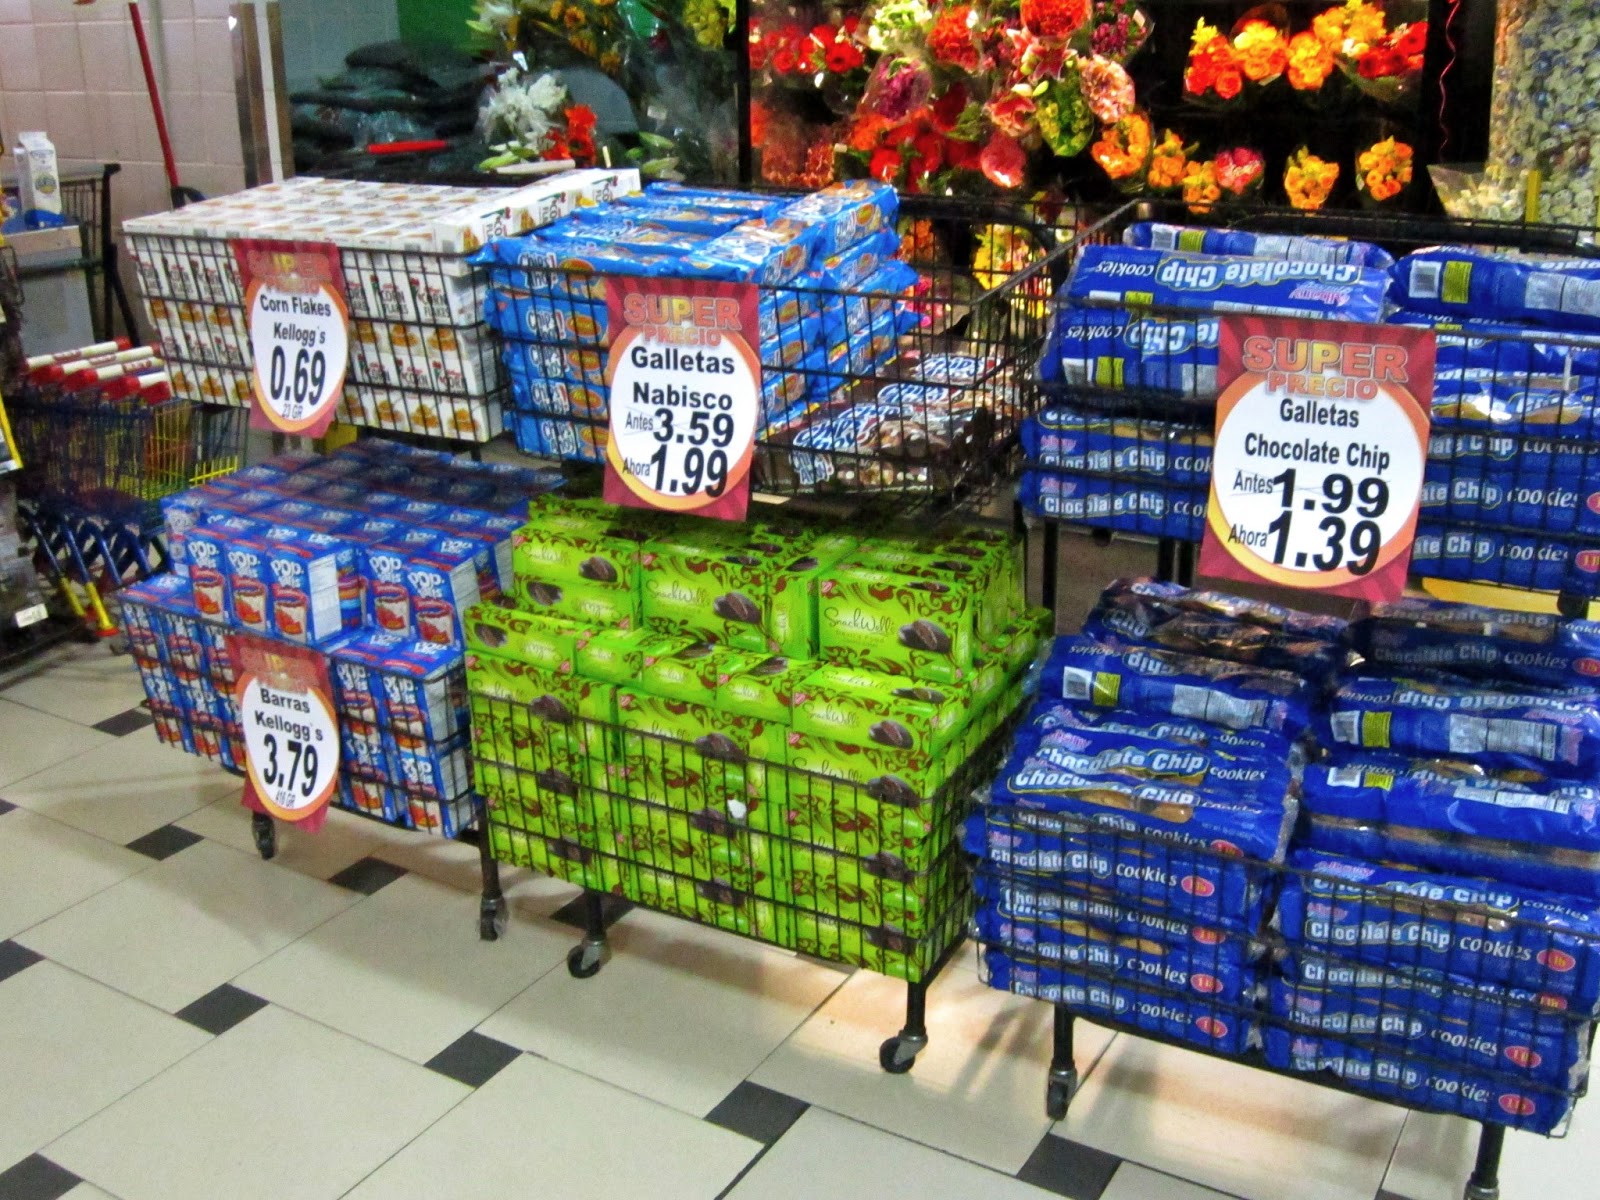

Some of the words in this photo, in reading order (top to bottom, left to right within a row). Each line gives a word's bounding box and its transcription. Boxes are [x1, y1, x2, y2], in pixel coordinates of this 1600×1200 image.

[1095, 260, 1155, 278] cookies
[1161, 261, 1218, 288] Chip
[1225, 260, 1354, 284] Chocolate
[260, 295, 289, 313] Corn
[292, 297, 332, 317] Flakes
[624, 292, 742, 331] SUPER
[642, 326, 721, 347] PRECIO
[1065, 325, 1124, 341] cookies
[1130, 323, 1186, 351] Chip
[631, 346, 735, 375] Galletas
[1243, 335, 1409, 383] SUPER
[270, 345, 326, 406] 0.69
[1266, 371, 1379, 400] PRECIO
[632, 382, 733, 410] Nabisco
[1280, 398, 1360, 428] Galletas
[625, 412, 654, 431] Antes
[653, 408, 734, 448] 3.59
[1128, 449, 1166, 470] Chip
[1245, 432, 1340, 465] Chocolate
[1347, 442, 1390, 475] Chip
[622, 457, 650, 477] Ahora
[650, 444, 728, 498] 1.99
[1128, 492, 1165, 514] Chip
[1233, 470, 1274, 494] Antes
[1273, 468, 1390, 519] 1.99
[1227, 523, 1268, 548] Ahora
[1268, 510, 1382, 577] 1.39
[260, 688, 311, 714] Barras
[1398, 691, 1451, 710] Chip
[263, 733, 318, 797] 3.79
[1036, 748, 1146, 772] Chocolate
[1152, 752, 1205, 773] Chip
[1210, 765, 1267, 782] cookies
[991, 849, 1064, 869] Chocolate
[1071, 853, 1108, 873] Chip
[1116, 863, 1178, 888] cookies
[1523, 900, 1590, 922] cookies
[1408, 922, 1450, 946] Chip
[1460, 937, 1532, 960] cookies
[1089, 988, 1126, 1010] Chip
[1381, 1012, 1423, 1036] Chp
